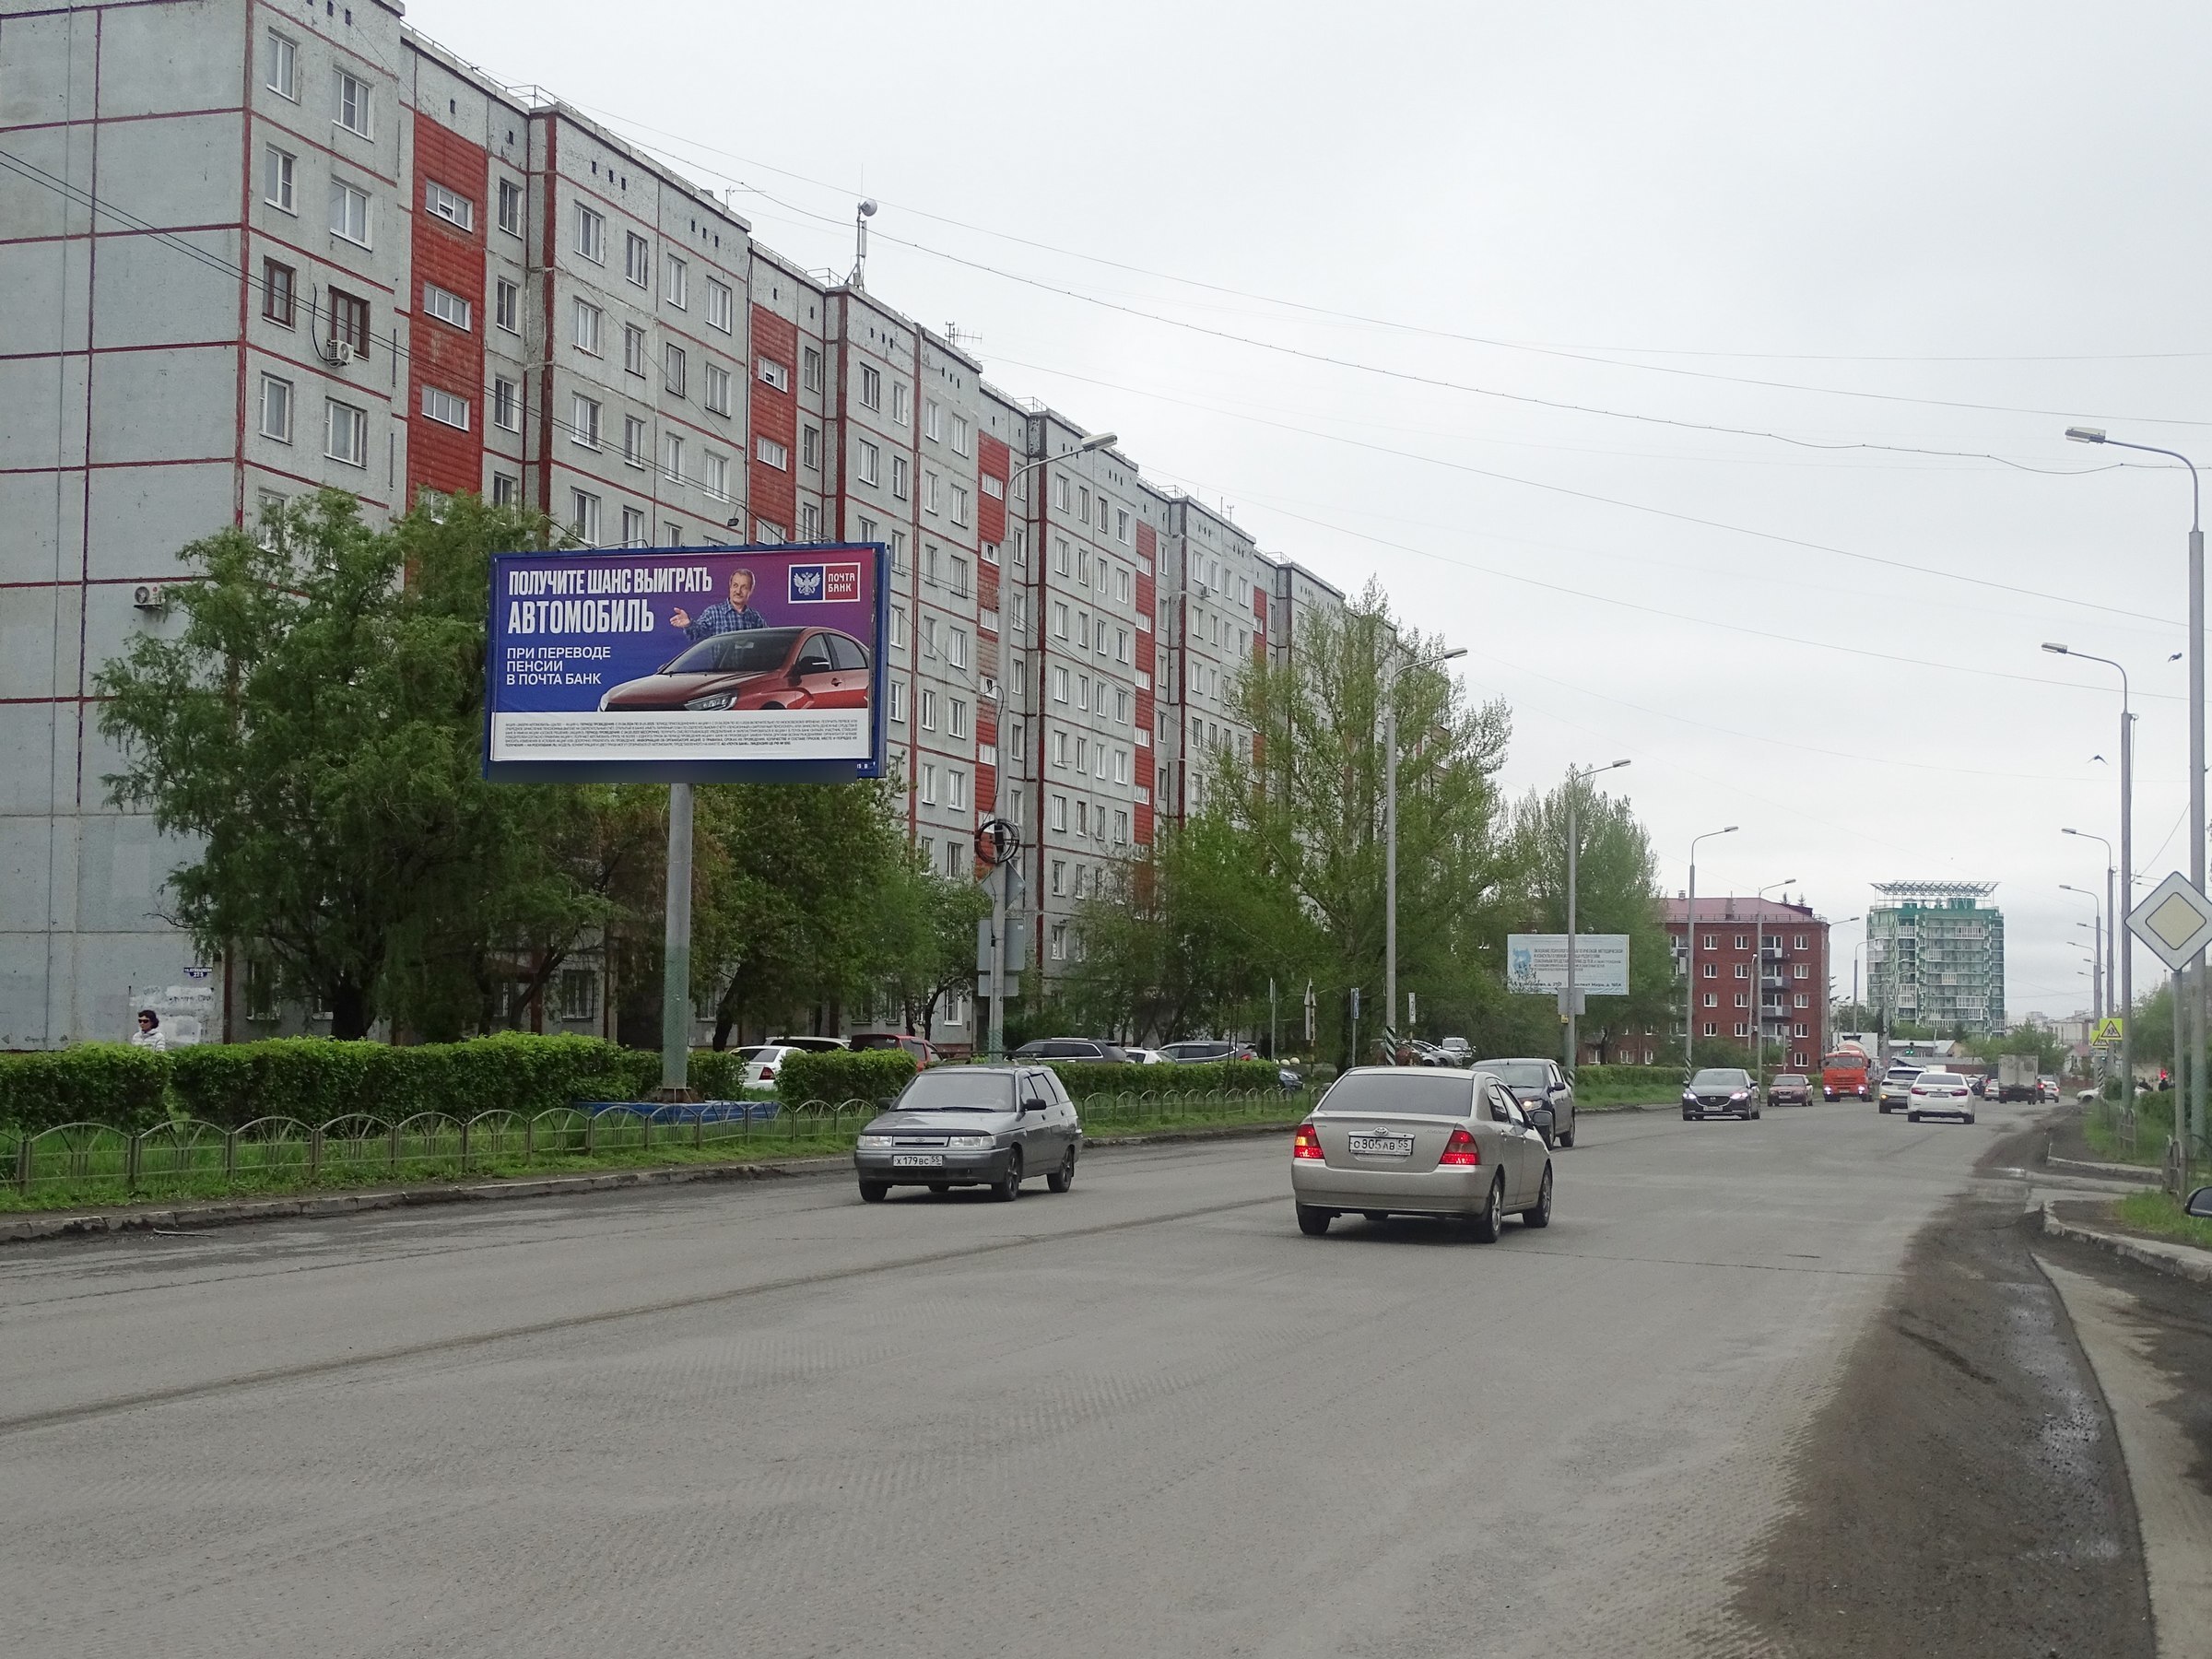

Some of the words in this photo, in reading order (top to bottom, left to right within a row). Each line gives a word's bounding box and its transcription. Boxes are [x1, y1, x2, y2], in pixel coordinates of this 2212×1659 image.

[509, 570, 585, 595] ПОЛУЧИТЕ
[587, 569, 631, 594] ШАНС
[633, 567, 712, 594] ВЫИГРАТЬ
[828, 572, 855, 582] ПОЧТА
[828, 582, 852, 593] БАНК
[507, 599, 654, 634] АВТОМОБИЛЬ
[507, 647, 535, 659] ПРИ
[538, 646, 611, 660] ПЕРЕВОДЕ
[506, 660, 563, 672] ПЕНСИИ
[506, 674, 515, 685] В
[519, 673, 562, 685] ПОЧТА
[565, 673, 602, 685] БАНК
